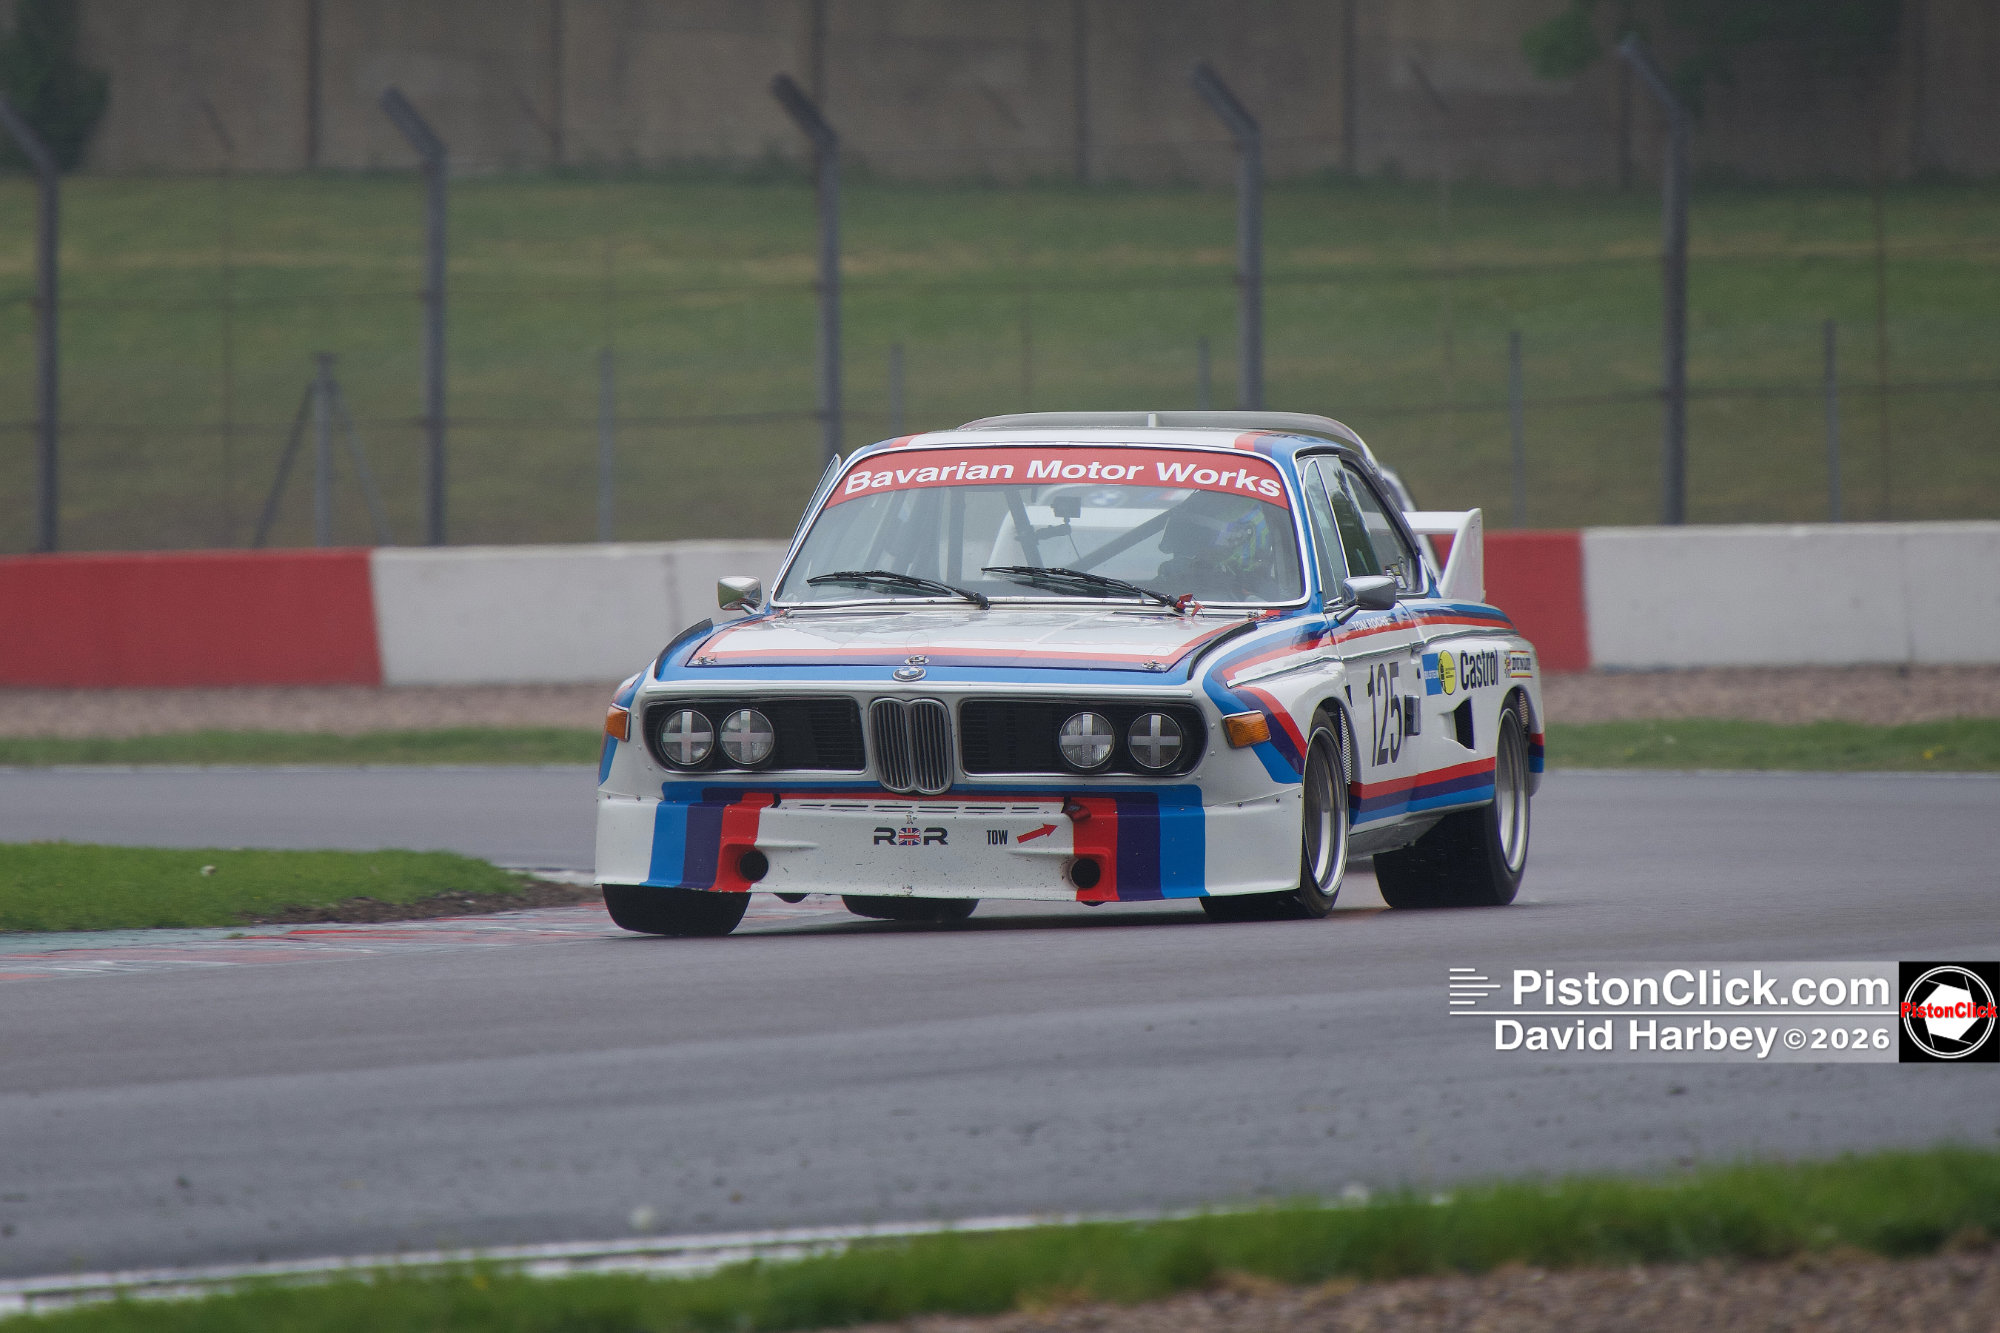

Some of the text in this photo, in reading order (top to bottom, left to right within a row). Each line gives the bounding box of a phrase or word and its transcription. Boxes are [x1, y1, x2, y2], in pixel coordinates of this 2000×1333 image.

[844, 459, 1281, 498] Bavarian Motor Works
[1460, 648, 1499, 691] Castrol
[1367, 661, 1402, 767] 125
[987, 830, 1008, 845] TOW
